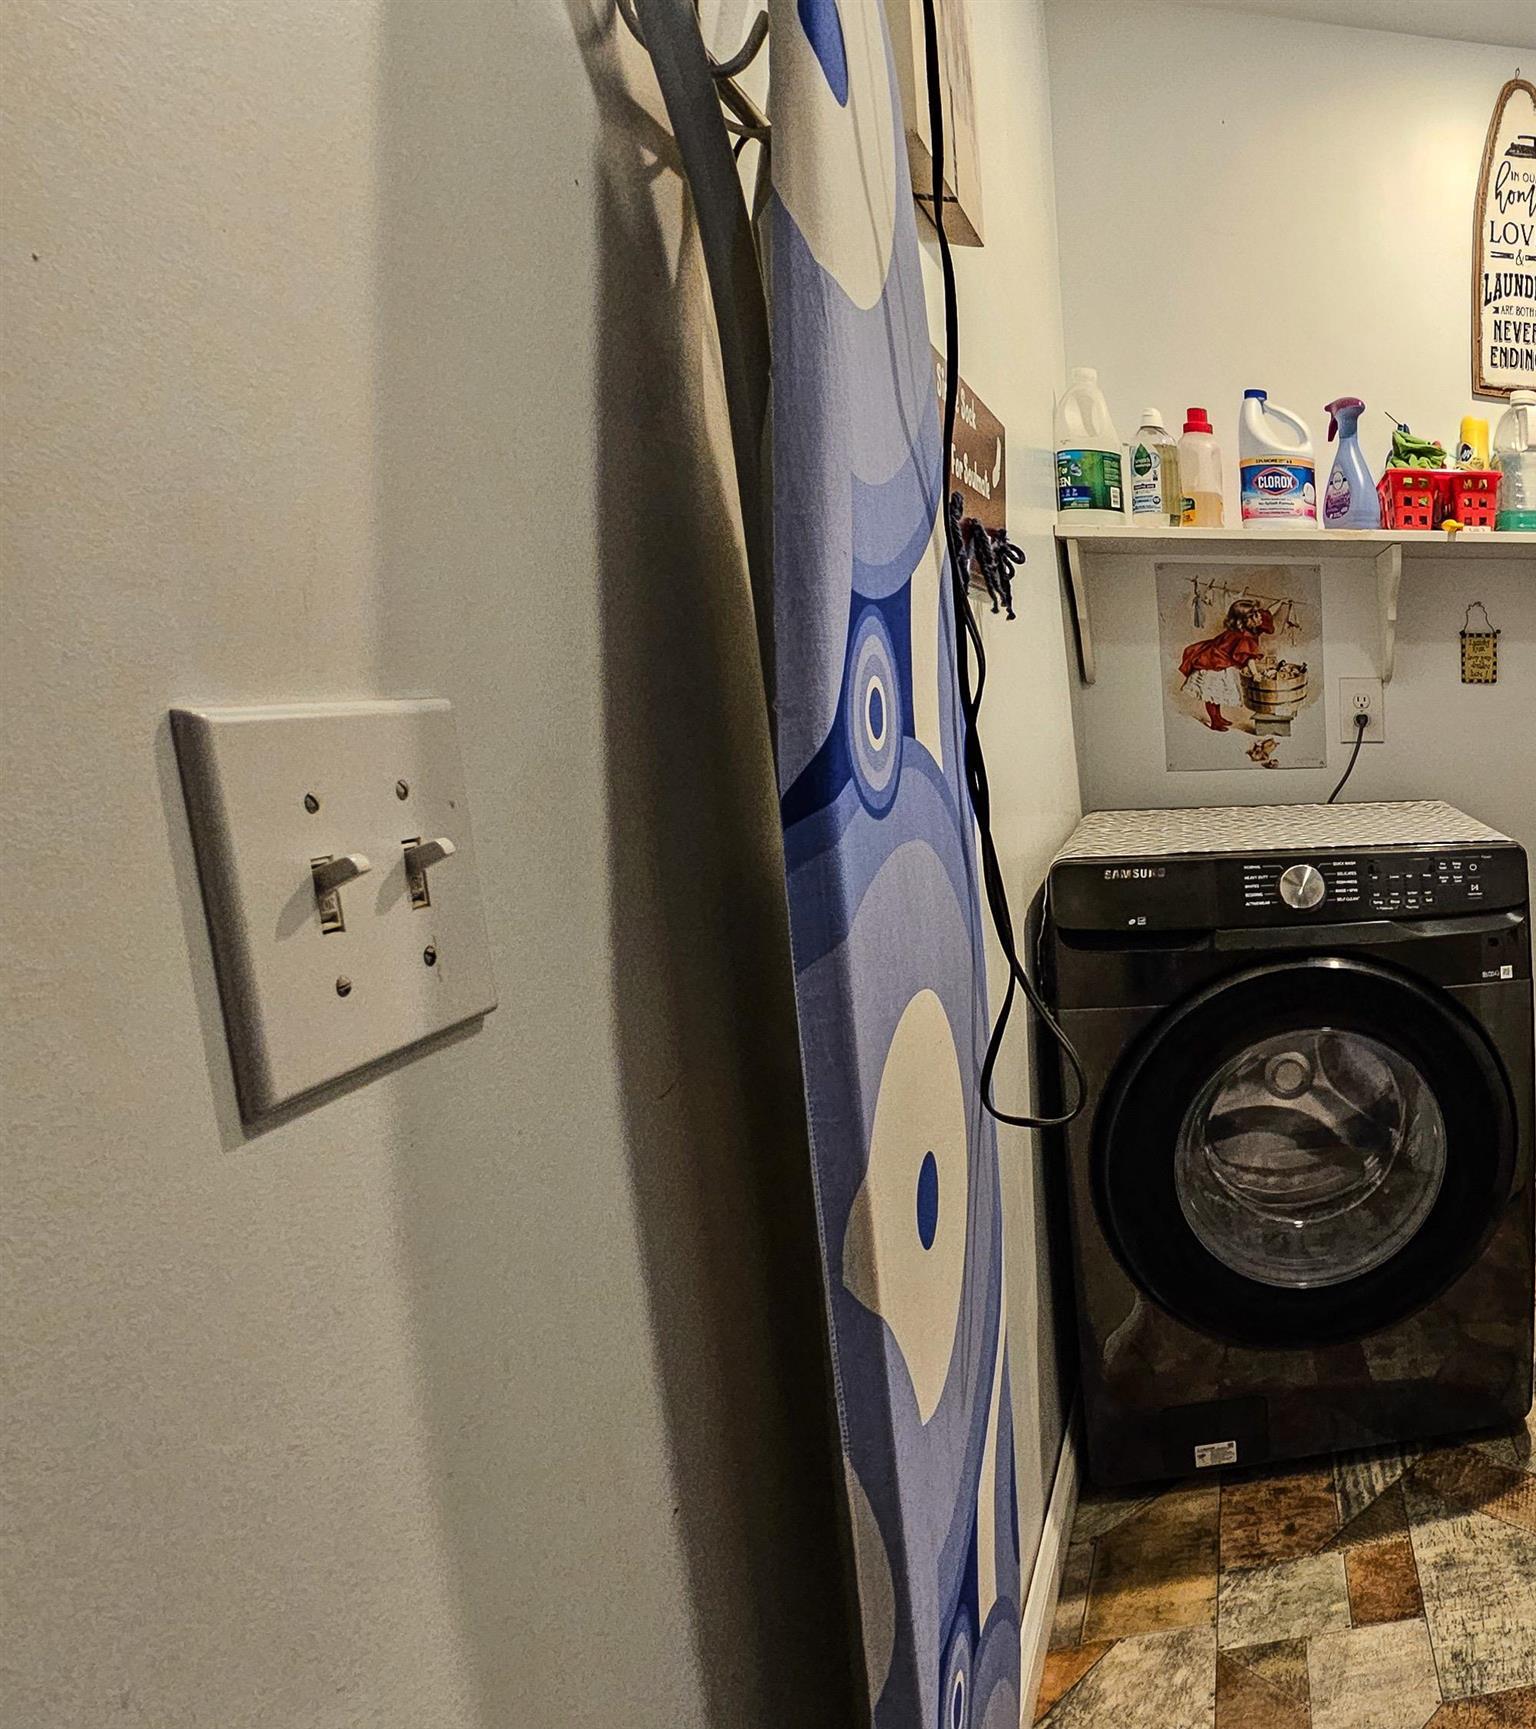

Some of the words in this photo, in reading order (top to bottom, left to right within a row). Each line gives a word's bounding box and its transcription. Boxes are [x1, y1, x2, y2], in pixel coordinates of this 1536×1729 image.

[1511, 171, 1519, 181] IN
[1515, 249, 1525, 266] &
[1501, 305, 1514, 316] ARE
[1516, 306, 1535, 318] BOTH
[1258, 475, 1293, 489] CLOROX
